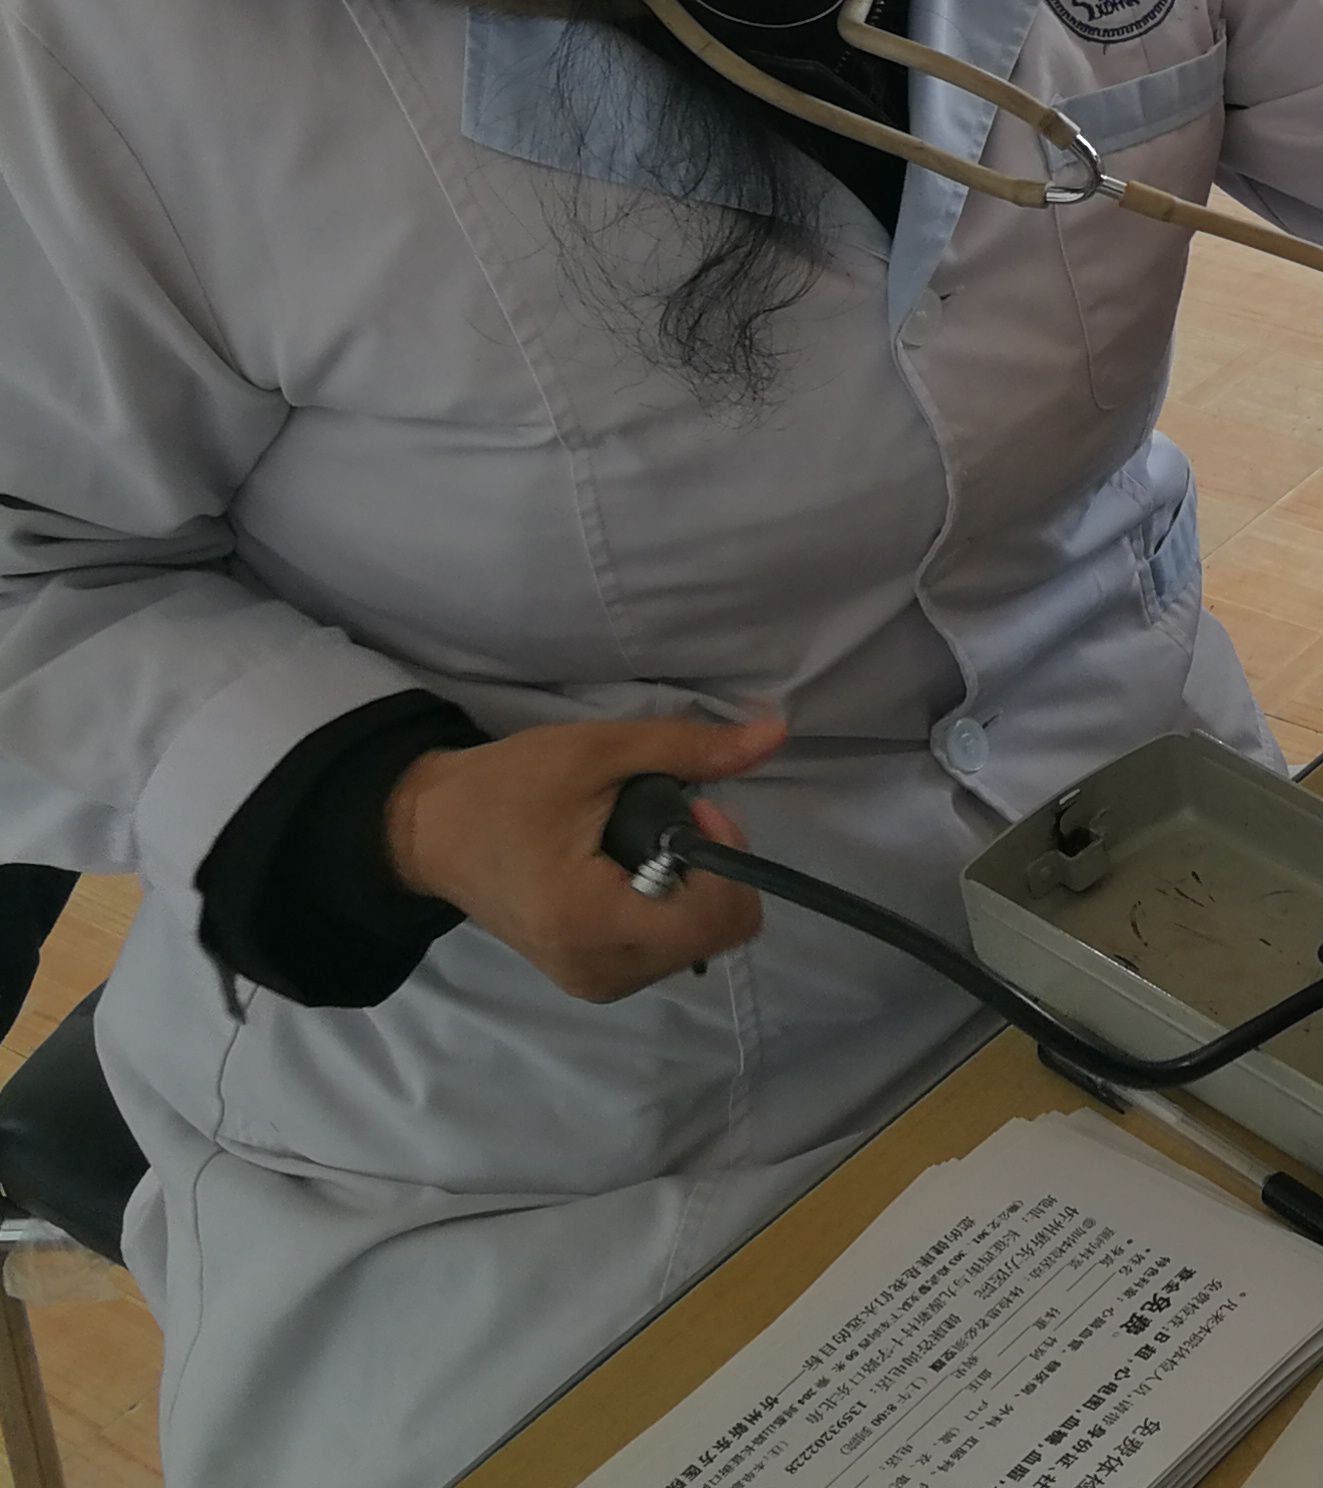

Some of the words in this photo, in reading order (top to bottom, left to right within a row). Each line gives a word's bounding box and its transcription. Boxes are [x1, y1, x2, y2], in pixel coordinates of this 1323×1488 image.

[971, 1201, 1080, 1304] 忻州新东方医院
[1096, 1242, 1125, 1270] 身高
[1116, 1250, 1145, 1279] 姓名
[1030, 1303, 1060, 1333] 体重
[1028, 1333, 1057, 1362] 性别
[951, 1352, 980, 1381] 病史
[964, 1366, 994, 1396] 血压
[962, 1397, 990, 1423] 户口
[1076, 1414, 1163, 1488] 免费体检
